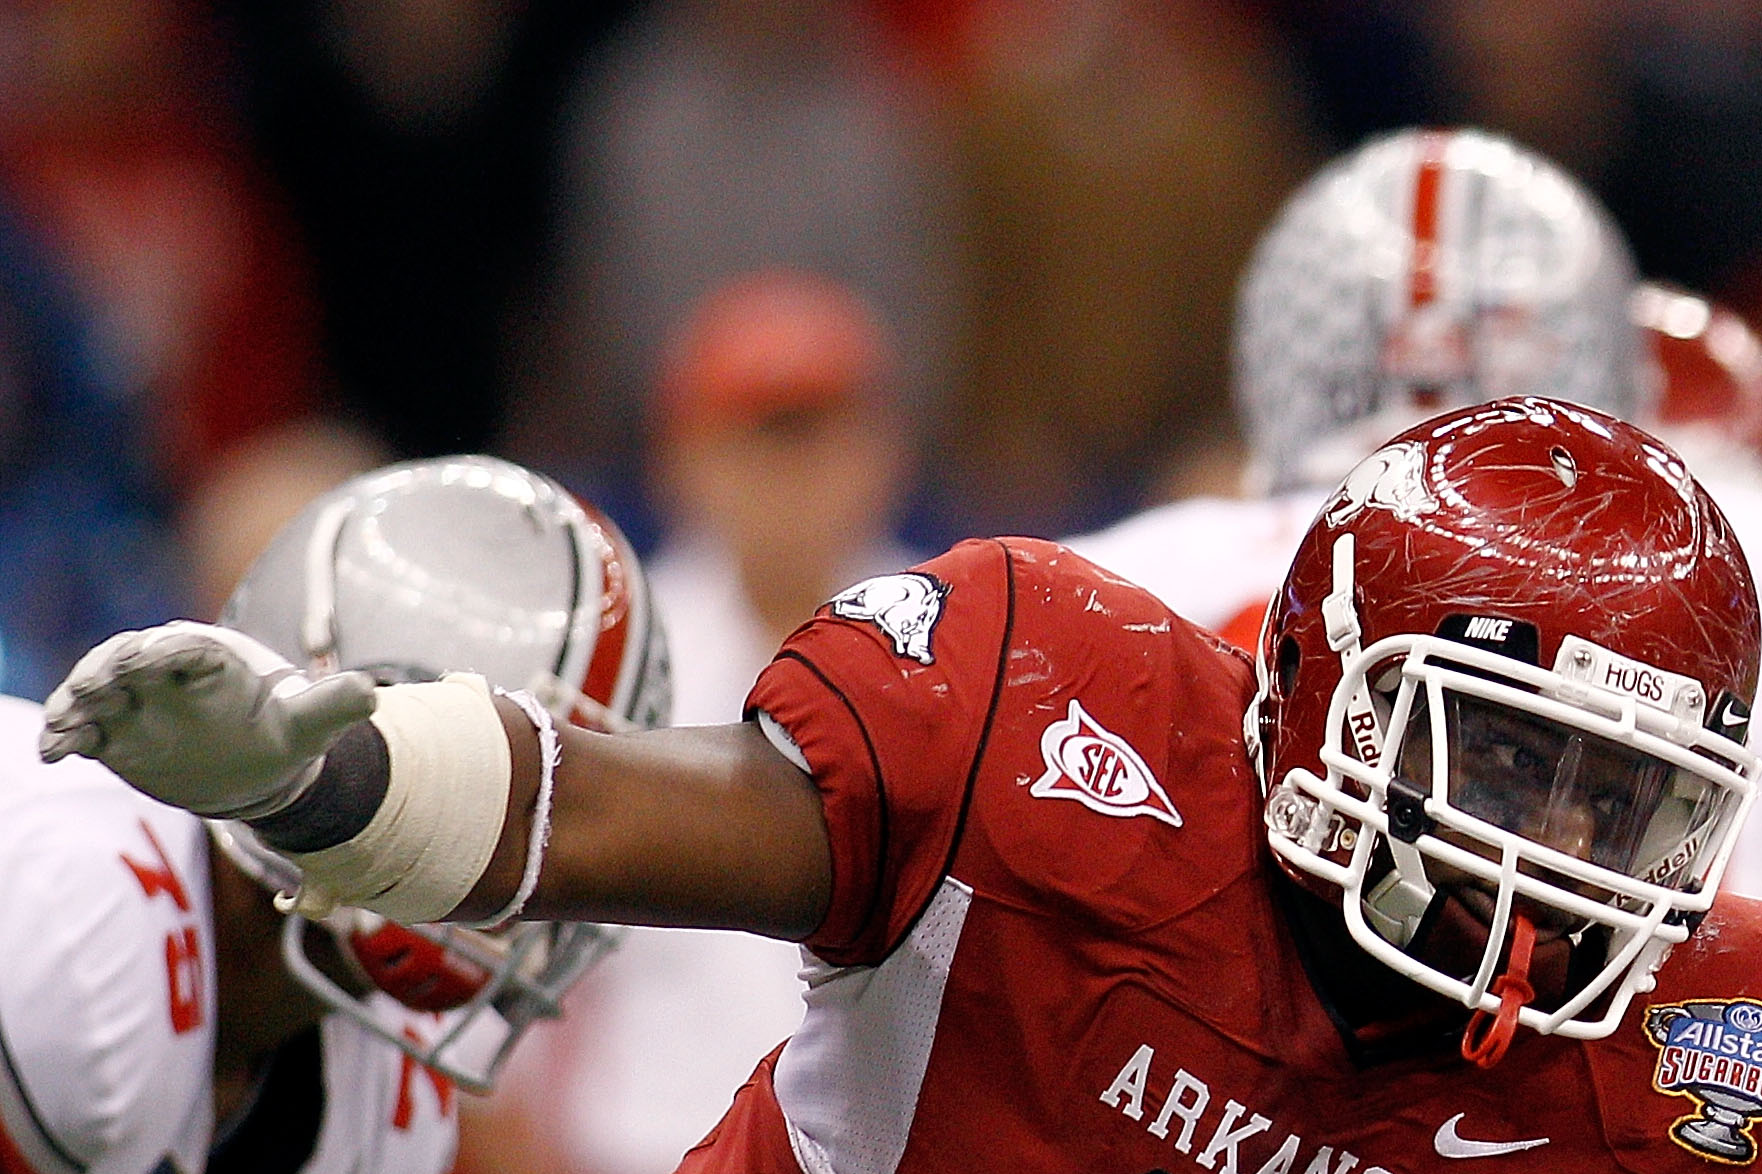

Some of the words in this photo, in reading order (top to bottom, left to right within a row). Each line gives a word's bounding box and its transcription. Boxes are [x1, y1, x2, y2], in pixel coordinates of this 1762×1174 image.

[1464, 616, 1513, 642] NIKE
[1605, 663, 1665, 702] HOGS
[1351, 701, 1381, 768] Rid
[1078, 743, 1129, 798] SEC
